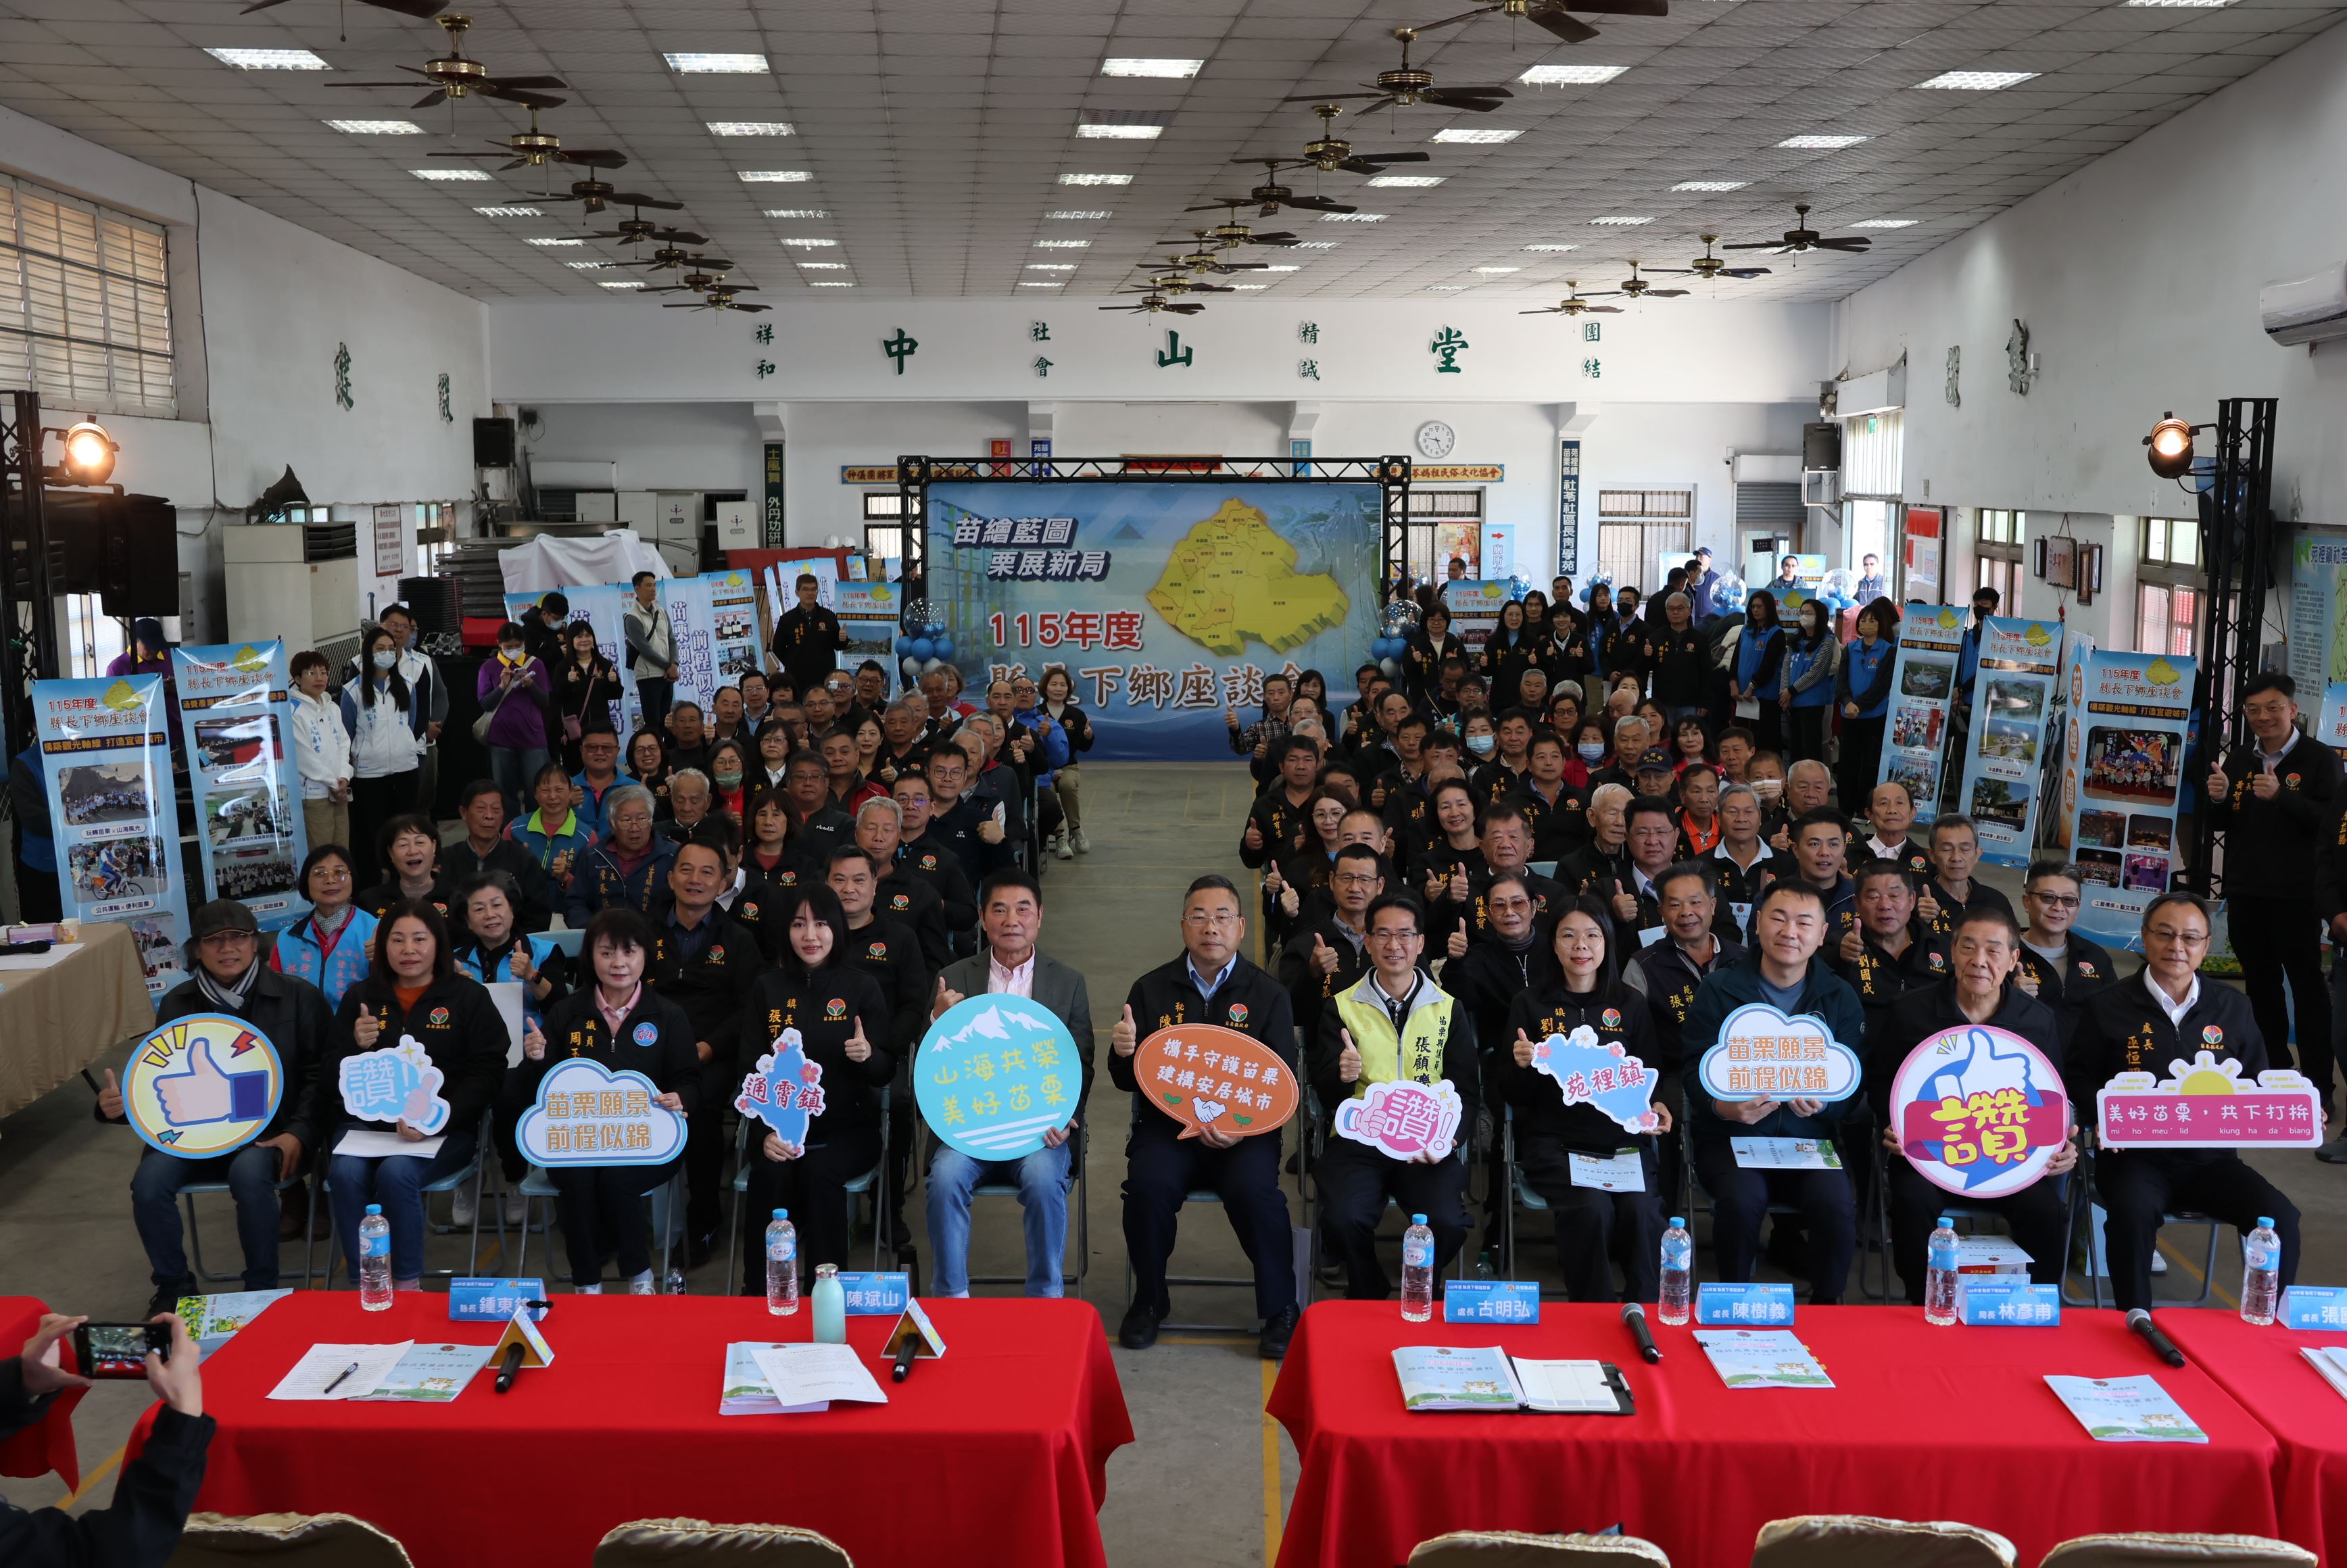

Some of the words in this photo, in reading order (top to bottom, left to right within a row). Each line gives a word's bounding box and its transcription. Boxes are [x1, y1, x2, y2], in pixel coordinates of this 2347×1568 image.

[755, 323, 775, 378] 祥和
[883, 328, 919, 375] 中
[1157, 329, 1193, 368] 山
[1431, 326, 1469, 374] 堂
[1032, 321, 1054, 378] 社會
[1300, 322, 1320, 383] 精誠
[1582, 321, 1602, 380] 團結
[953, 516, 1073, 545] 苗繪藍圖
[988, 550, 1107, 578] 栗展新局
[990, 610, 1143, 649] 115年度
[990, 662, 1302, 708] 下鄉座談
[2102, 668, 2141, 681] 115年度
[49, 697, 97, 712] 115年度
[2099, 682, 2183, 700] 縣長下鄉座談會
[656, 939, 664, 960] 里長
[1859, 954, 1874, 995] 劉國成
[379, 1005, 388, 1031] 主席
[784, 998, 798, 1025] 鎮長
[1554, 1007, 1567, 1033] 鎮長
[585, 1019, 597, 1048] 議員
[1728, 1035, 1827, 1060] 苗栗願景
[2142, 1021, 2154, 1051] 處長
[934, 1037, 1061, 1085] 山海共榮
[1163, 1038, 1279, 1086] 攜手守護苗栗
[1157, 1064, 1273, 1110] 建構安居城市
[1566, 1062, 1646, 1100] 苑裡鎮
[1728, 1065, 1829, 1092] 前程似錦
[545, 1091, 650, 1118] 苗栗願景
[745, 1077, 823, 1112] 通霄鎮
[942, 1074, 1067, 1126] 美好苗栗
[546, 1123, 651, 1150] 前程似錦
[1930, 1087, 2031, 1167] 讚
[2219, 1127, 2240, 1136] kiung
[2289, 1127, 2310, 1136] biang
[846, 1290, 898, 1307] 陳斌山
[1457, 1308, 1474, 1317] 處長
[1478, 1300, 1530, 1317] 古明弘
[1712, 1309, 1729, 1318] 處長
[1733, 1302, 1786, 1319] 陳樹義
[1998, 1302, 2052, 1320] 林彥甫
